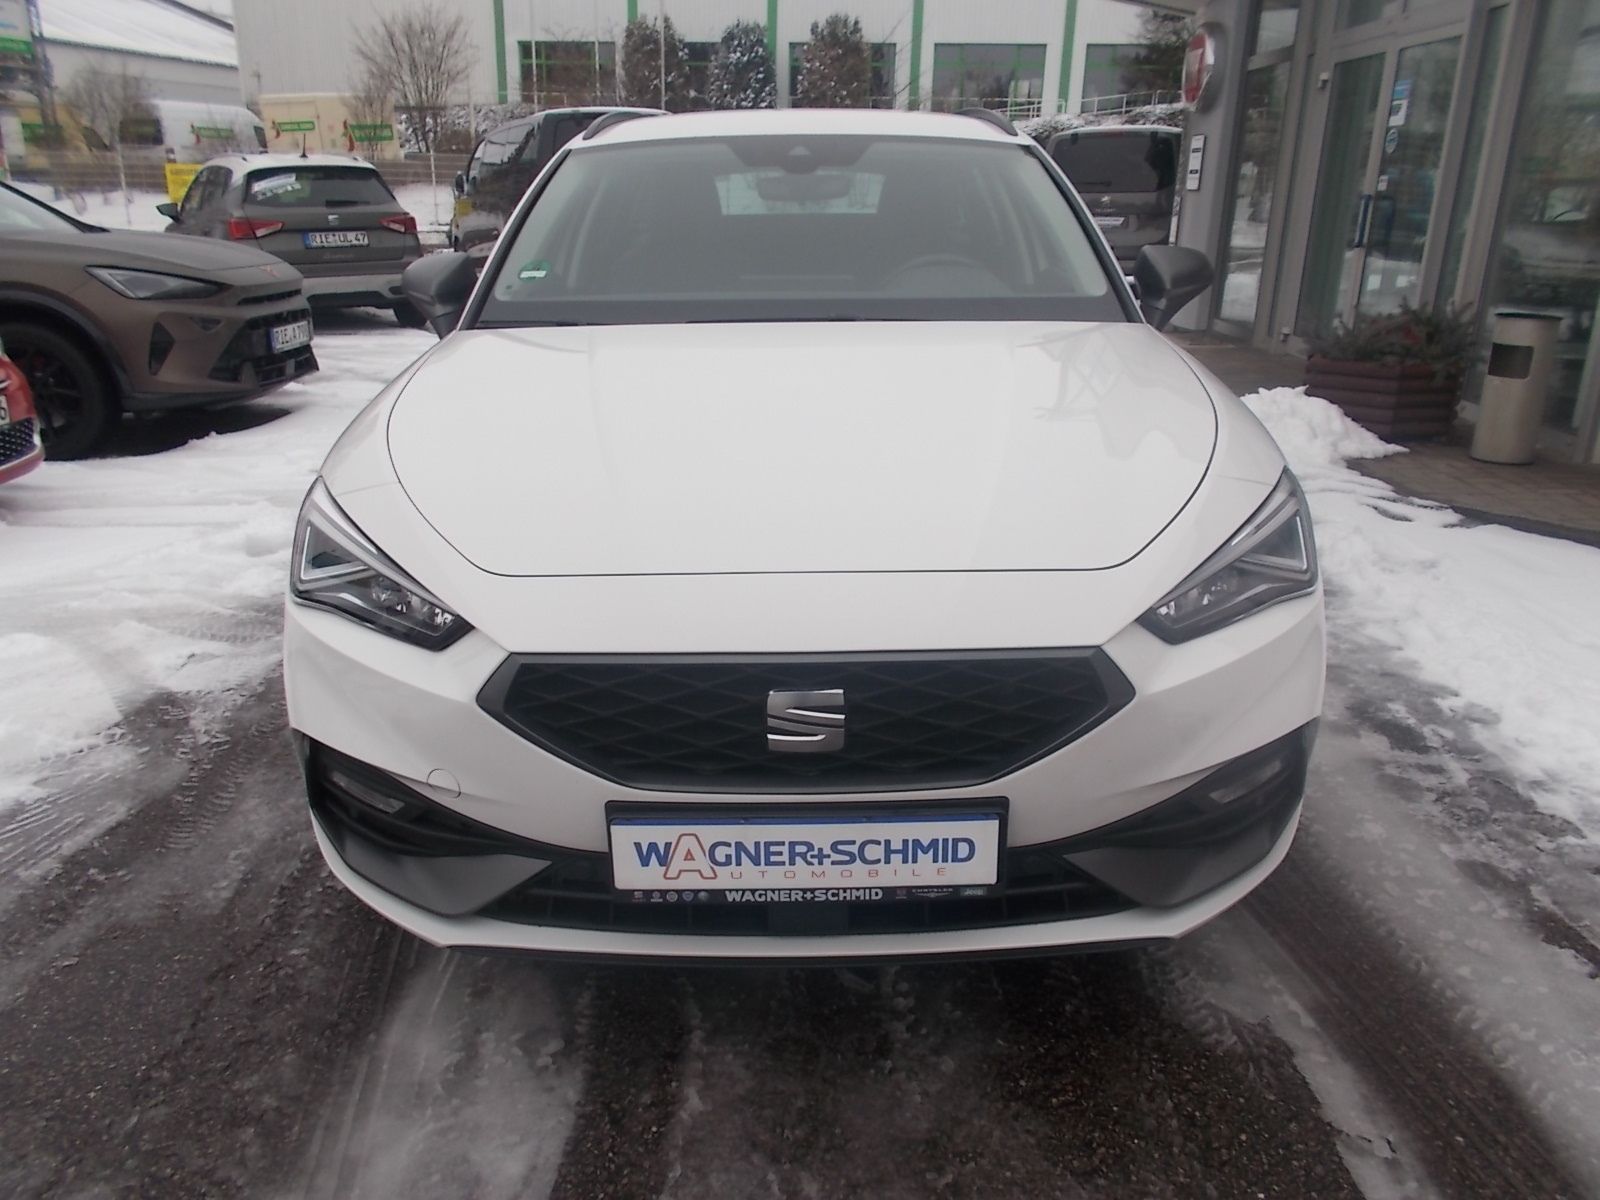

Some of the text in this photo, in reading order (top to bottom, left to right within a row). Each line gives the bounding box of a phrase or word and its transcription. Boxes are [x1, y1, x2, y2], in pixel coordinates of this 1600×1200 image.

[310, 233, 332, 244] RIE
[354, 232, 367, 243] 47
[633, 833, 976, 880] WAGNER+SCHMID
[725, 888, 883, 902] WAGNER+SCHMID
